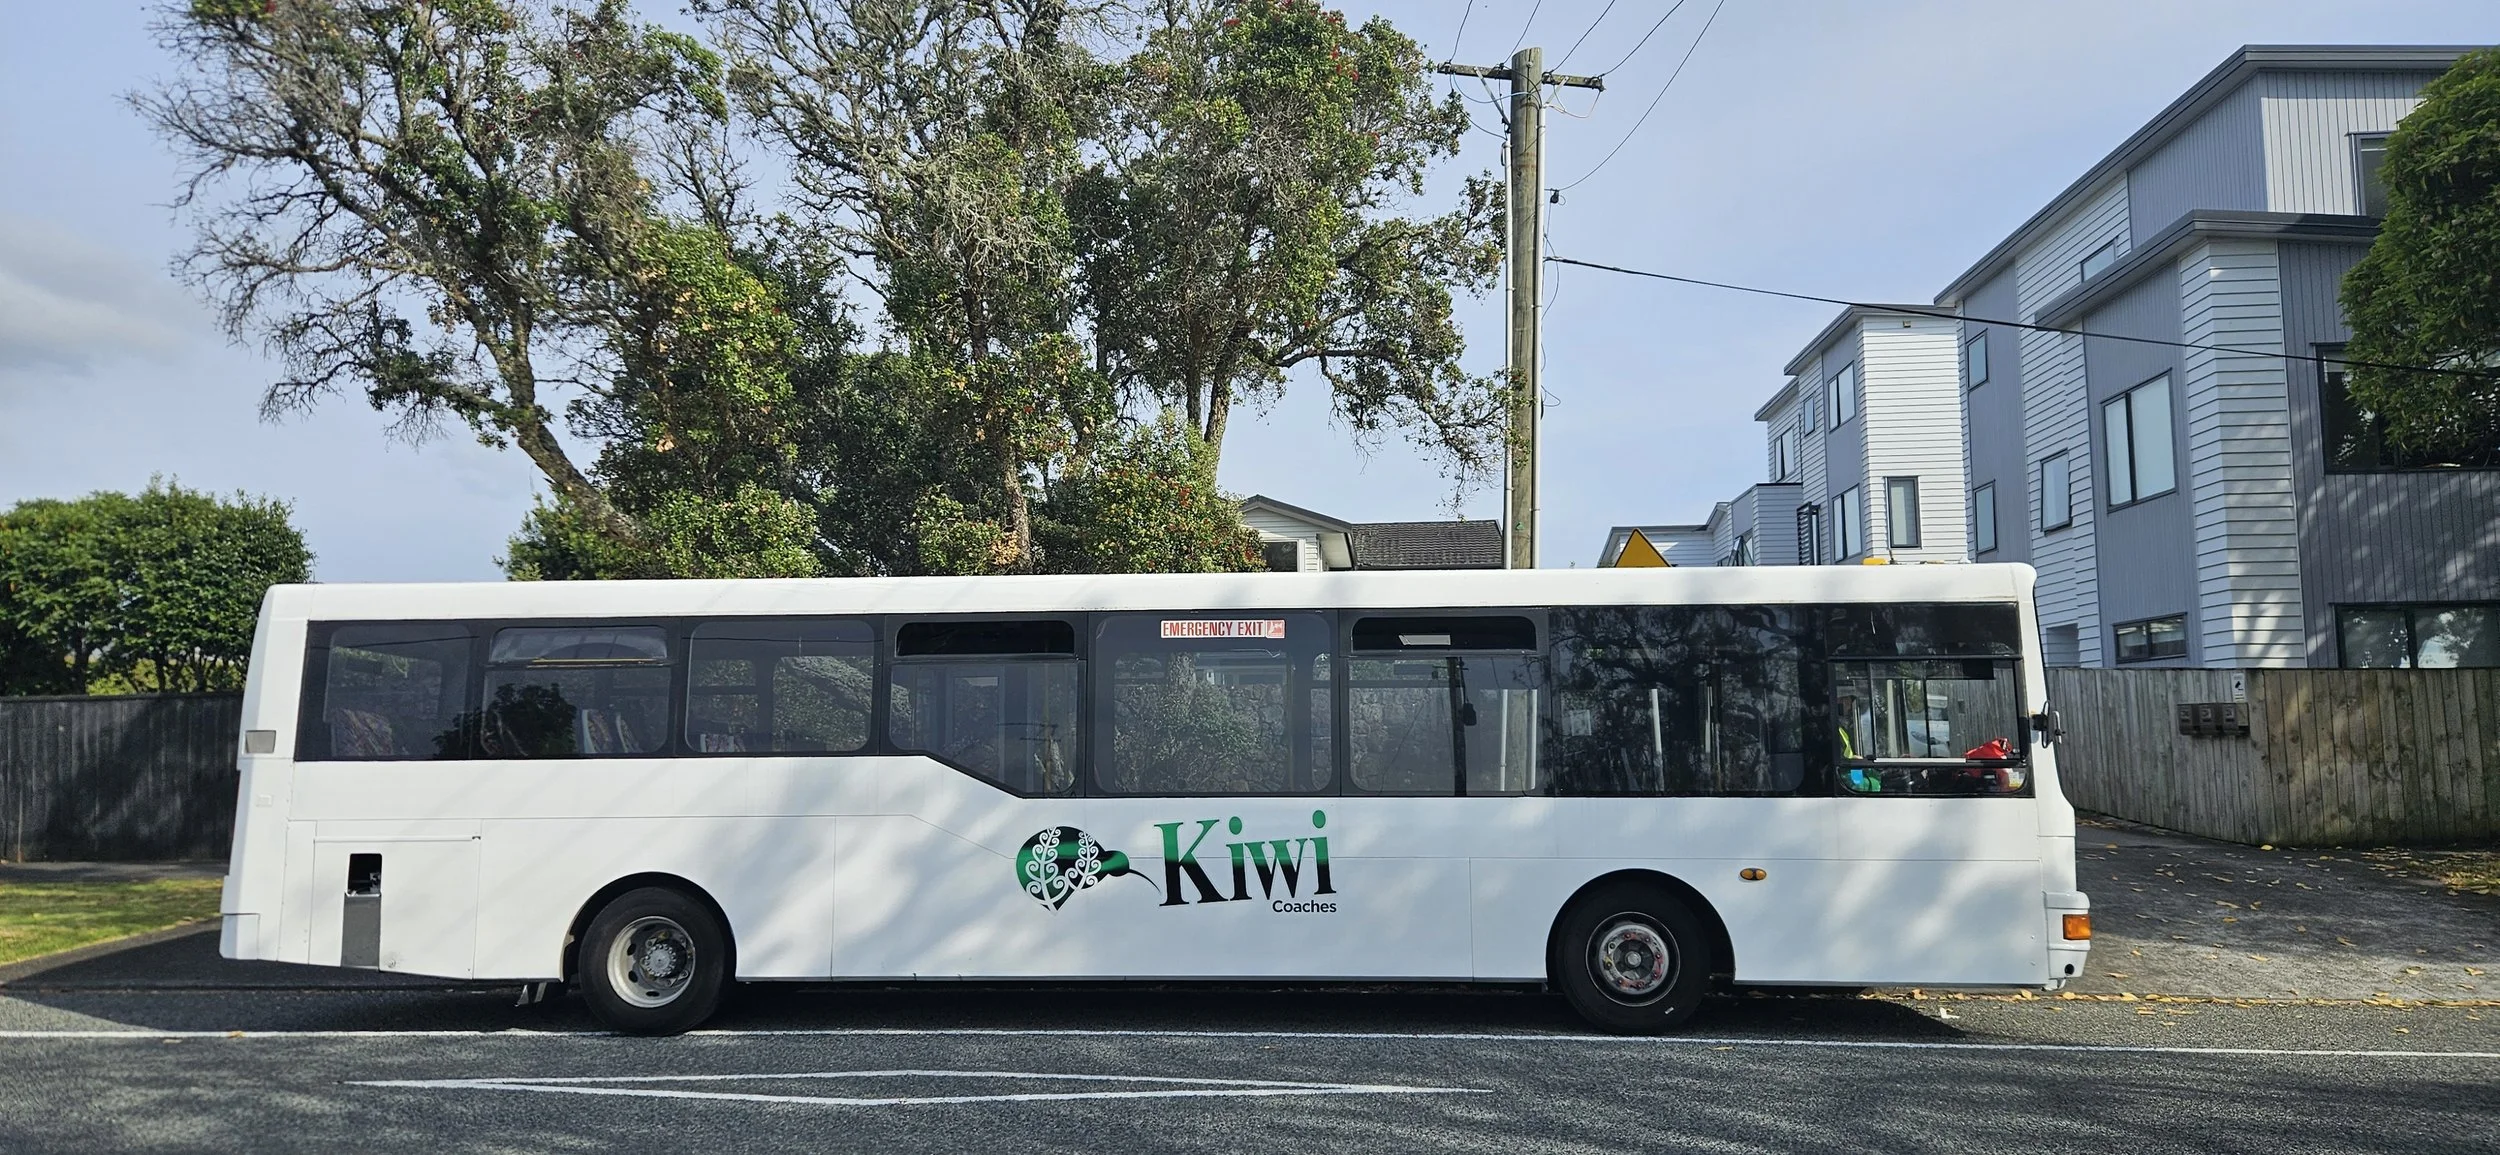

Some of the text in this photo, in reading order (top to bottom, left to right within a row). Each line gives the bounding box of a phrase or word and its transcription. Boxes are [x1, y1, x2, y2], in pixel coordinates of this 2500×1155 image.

[1163, 621, 1264, 636] EMERGENCY EXIT
[1153, 809, 1337, 907] Kiwi
[1272, 899, 1337, 913] Coaches
